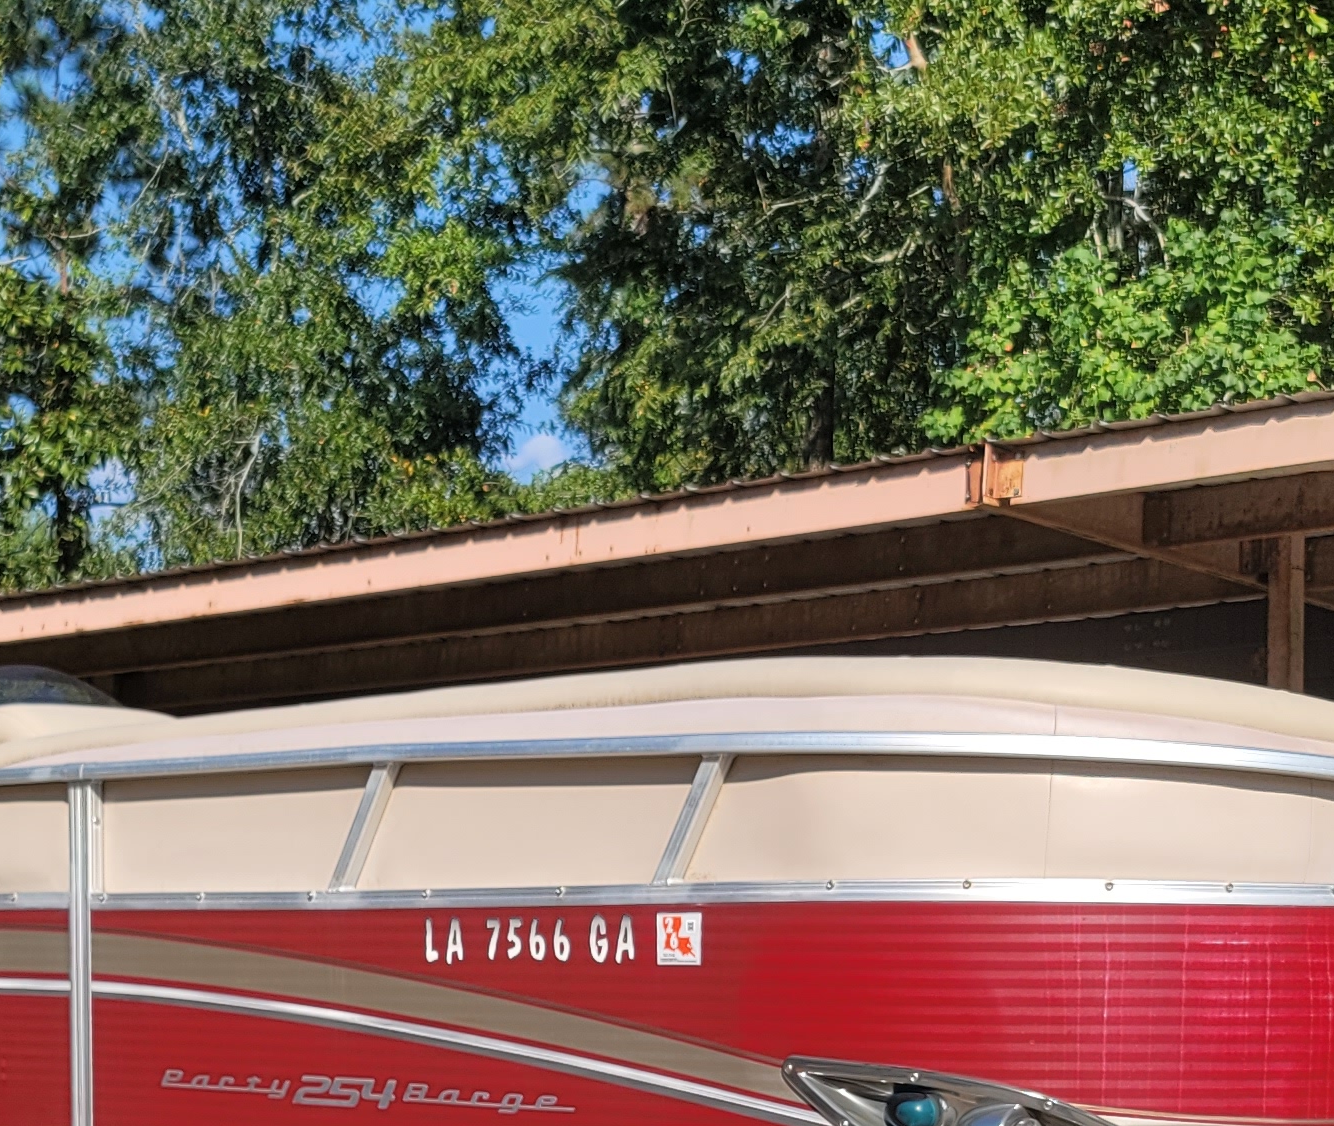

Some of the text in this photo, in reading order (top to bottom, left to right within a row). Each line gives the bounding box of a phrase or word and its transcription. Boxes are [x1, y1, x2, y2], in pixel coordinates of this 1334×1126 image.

[425, 914, 635, 965] LA 7566 GA
[161, 1069, 576, 1114] Party 254 Barge
